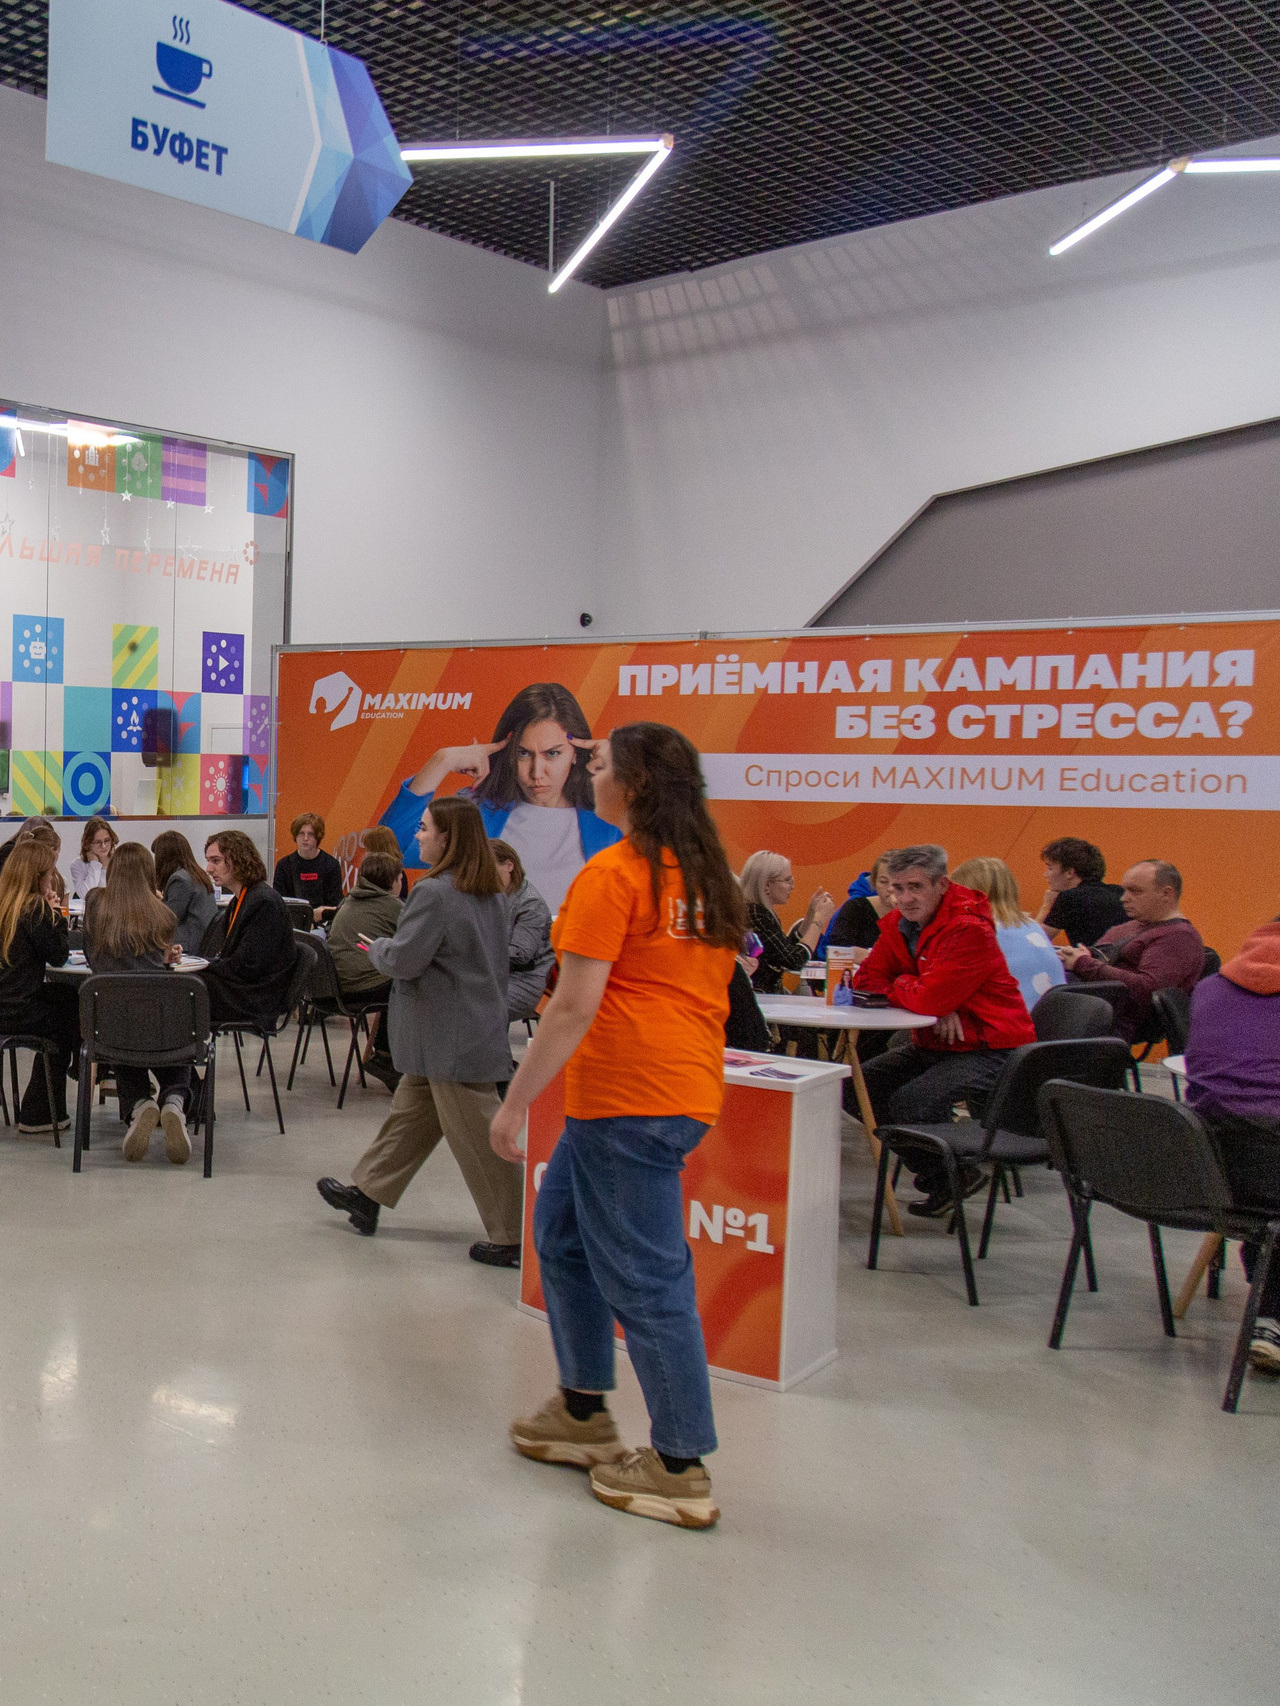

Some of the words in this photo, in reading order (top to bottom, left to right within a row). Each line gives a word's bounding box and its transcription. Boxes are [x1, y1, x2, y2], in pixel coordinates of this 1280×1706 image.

[130, 116, 229, 177] БУФЕТ
[113, 549, 241, 585] ПЕРЕМЕНА
[618, 653, 893, 696] ПРИЁМНАЯ
[903, 650, 1256, 693] КАМПАНИЯ
[360, 711, 405, 720] EDUCATION
[362, 692, 473, 711] MAXIMUM
[834, 704, 937, 740] БЕЗ
[947, 702, 1254, 740] СТРЕССА?
[744, 764, 861, 793] Спроси
[871, 766, 1046, 792] MAXIMUM
[1058, 767, 1249, 794] Education
[688, 1199, 776, 1255] №1
